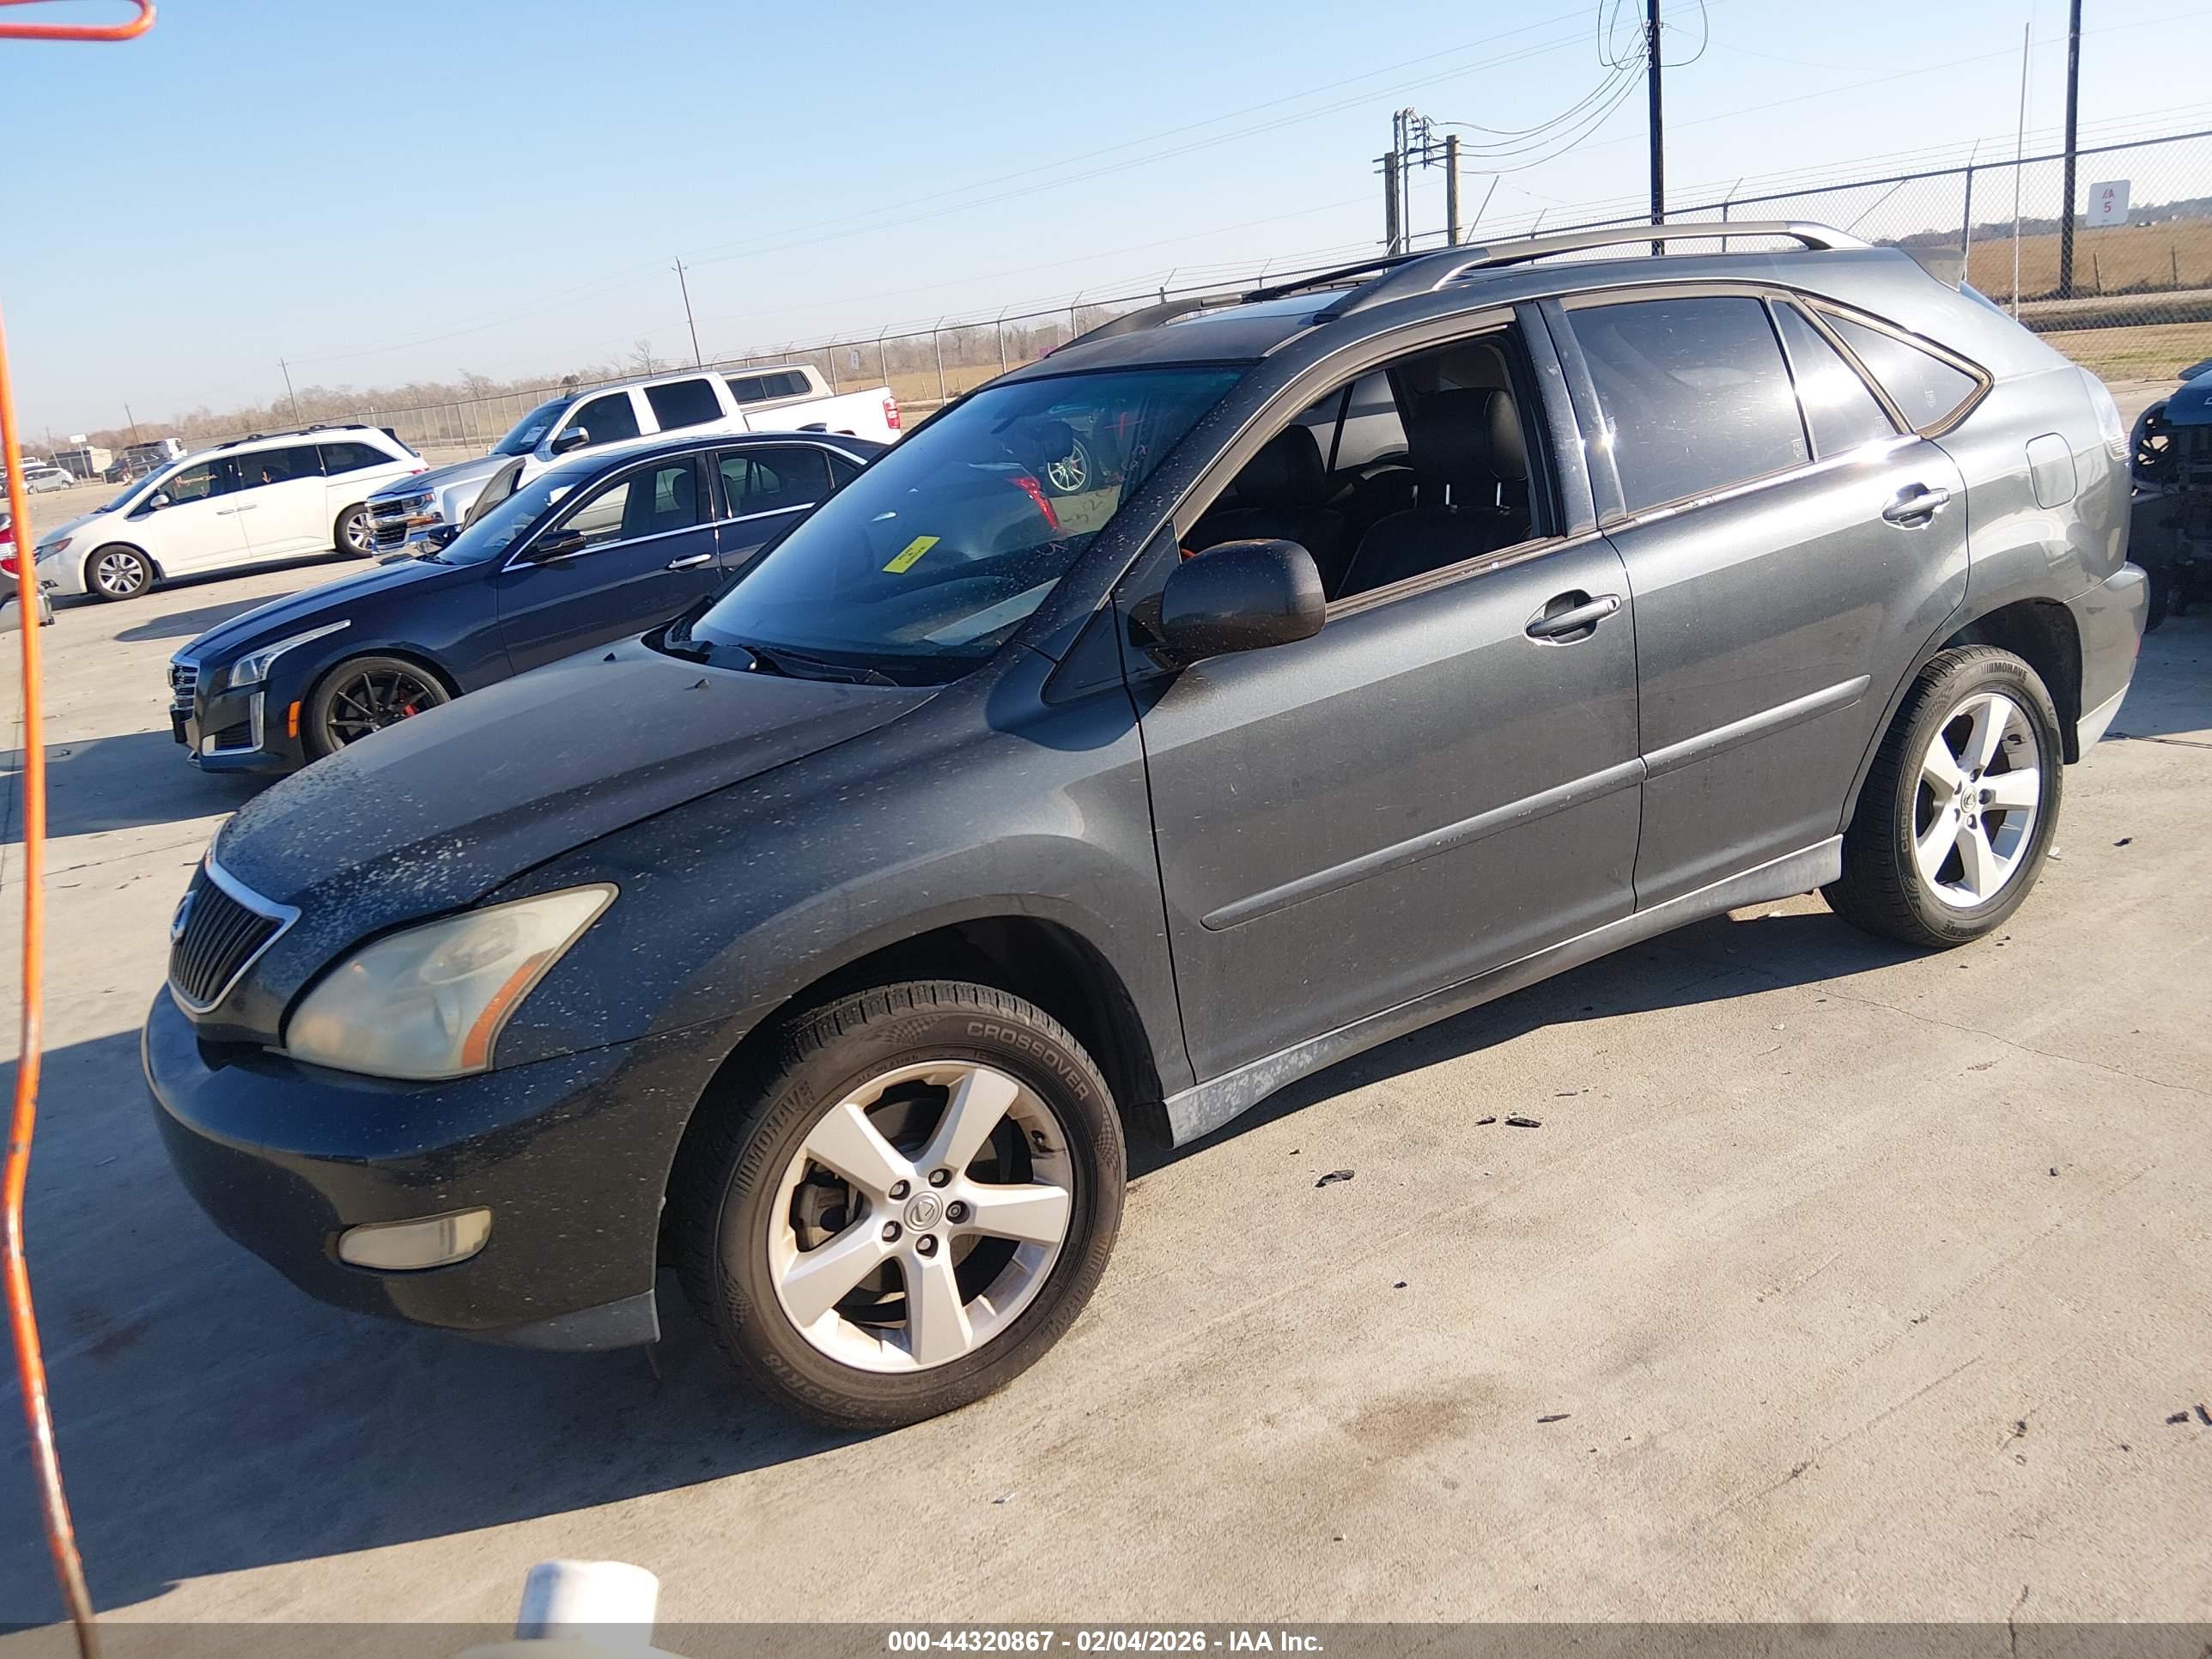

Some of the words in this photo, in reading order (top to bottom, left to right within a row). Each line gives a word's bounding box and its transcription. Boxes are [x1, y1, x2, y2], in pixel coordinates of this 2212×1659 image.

[2103, 201, 2112, 214] 5
[1993, 662, 2027, 679] MOHAVE
[967, 1021, 1090, 1101] CROSSOVER
